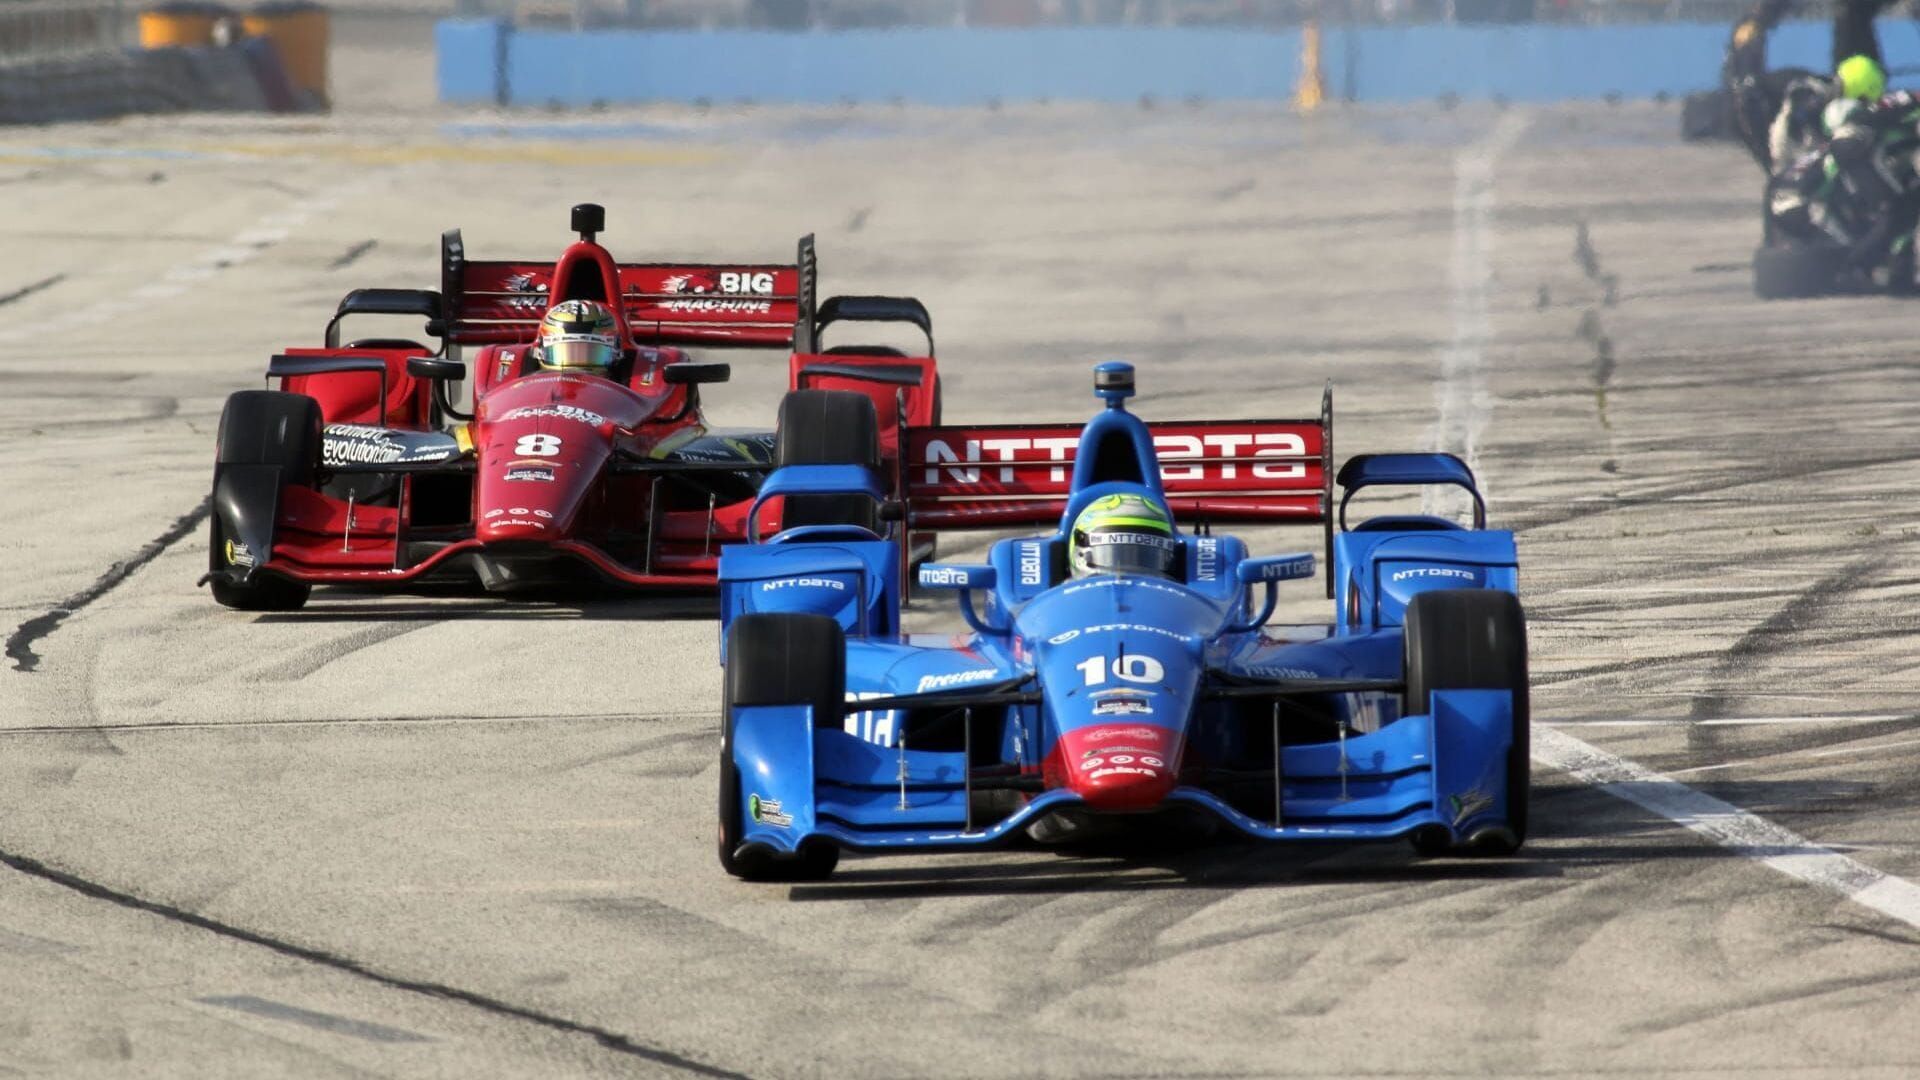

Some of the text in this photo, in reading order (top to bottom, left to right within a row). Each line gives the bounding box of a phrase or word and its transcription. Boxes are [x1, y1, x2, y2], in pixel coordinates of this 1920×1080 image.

[720, 272, 773, 293] BIG
[515, 434, 562, 456] 8
[925, 437, 1081, 484] NTT
[1108, 534, 1133, 544] NTT
[763, 579, 797, 592] NTT
[1393, 569, 1427, 581] NTT
[1076, 654, 1164, 686] 10
